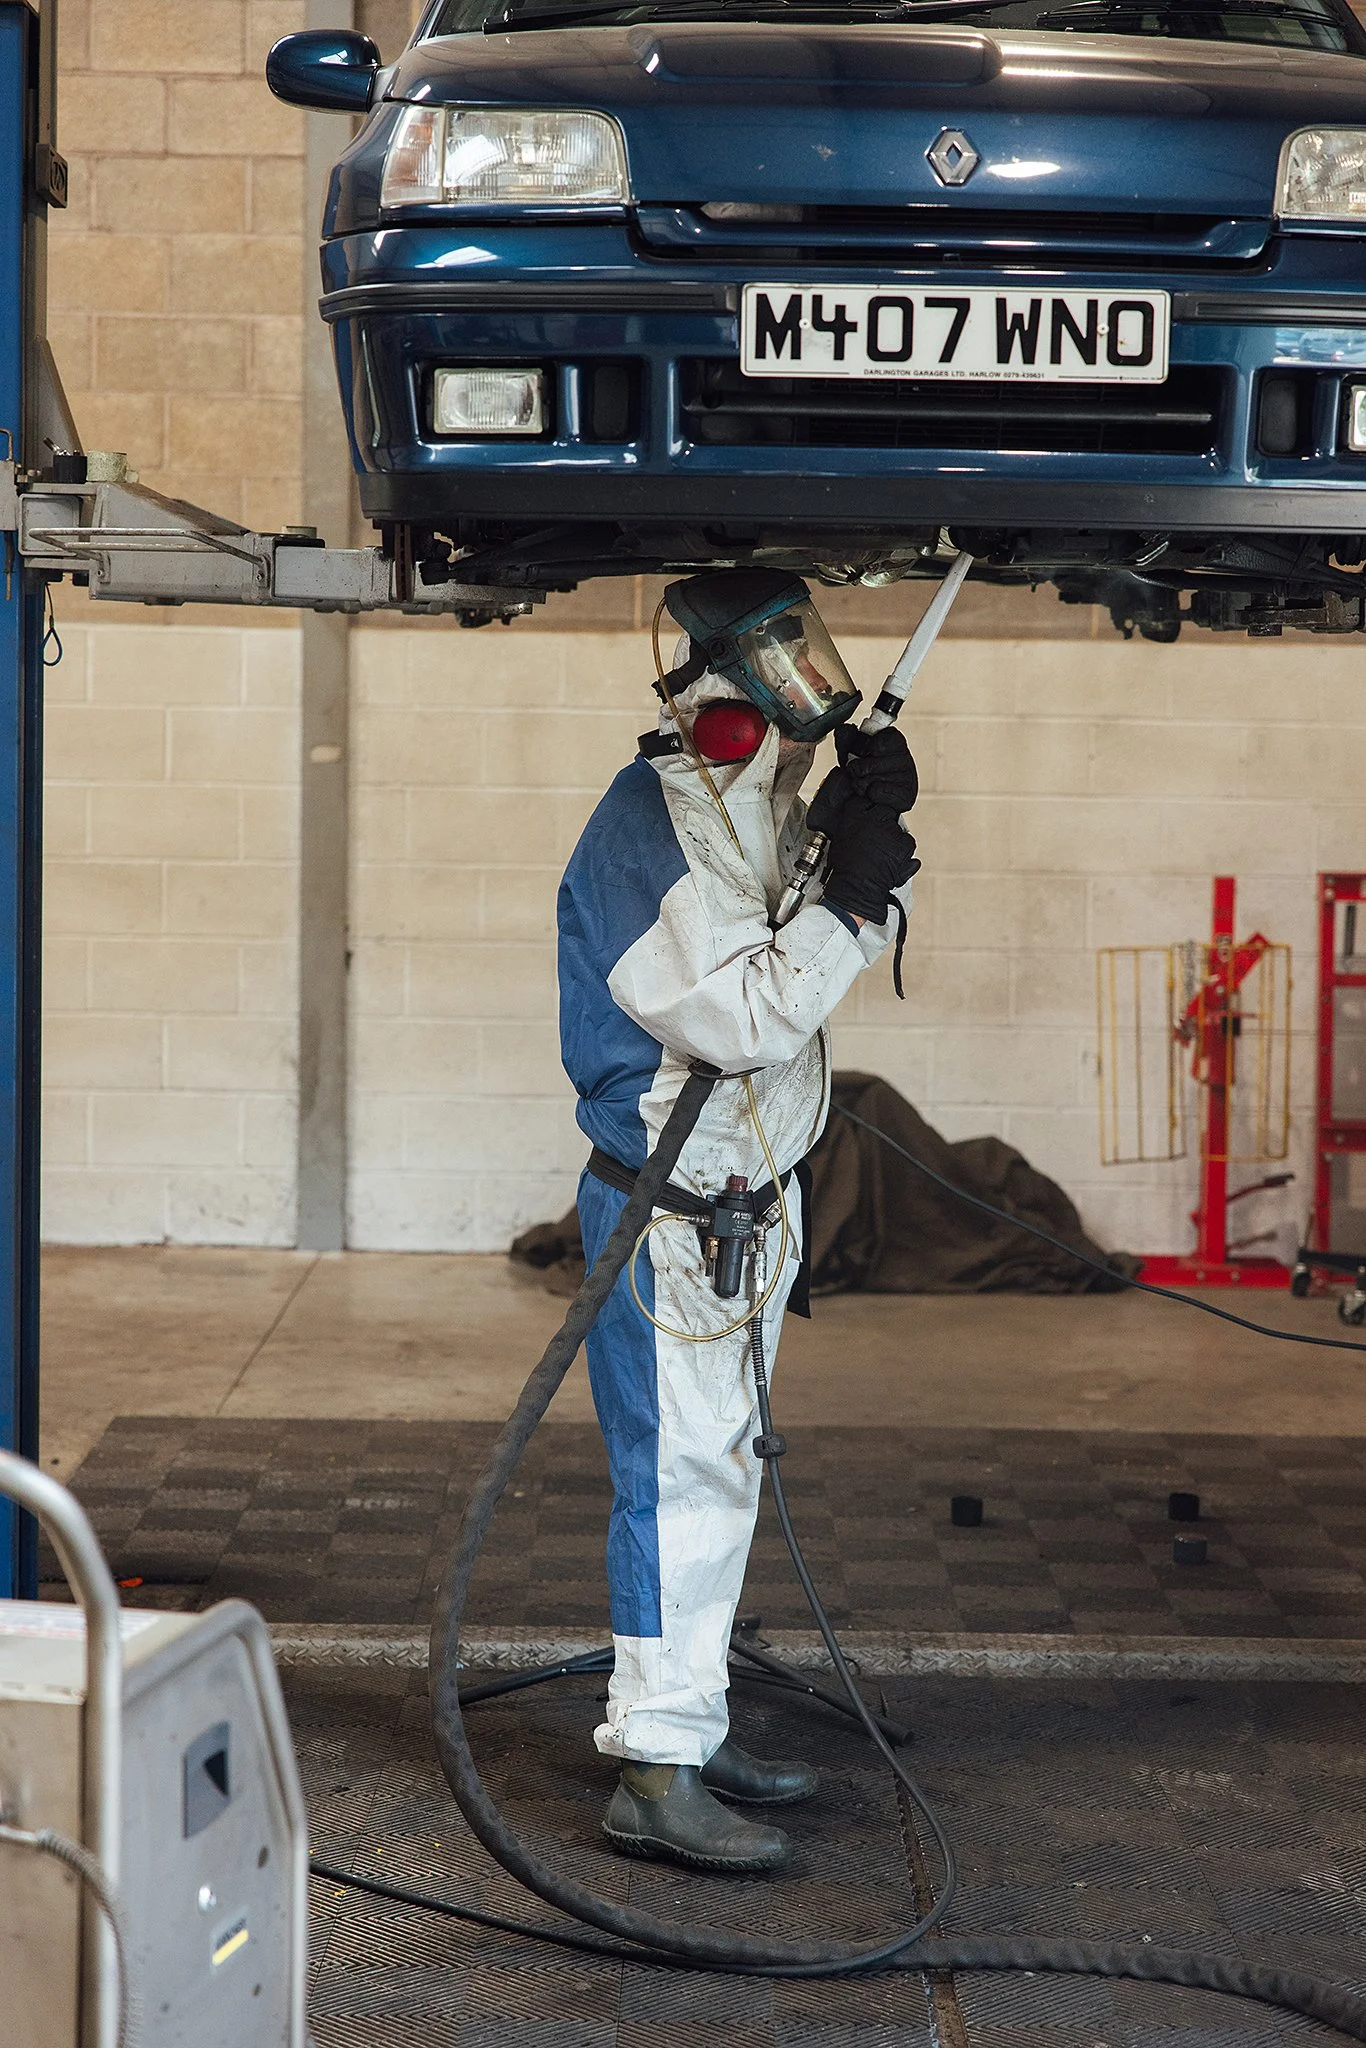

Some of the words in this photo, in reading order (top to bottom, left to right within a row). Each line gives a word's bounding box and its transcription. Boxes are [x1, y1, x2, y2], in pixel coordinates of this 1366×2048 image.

[754, 293, 971, 364] M407
[995, 297, 1155, 367] WNO
[863, 369, 911, 377] DARLINGTON
[913, 369, 949, 377] GARAGES
[969, 371, 1001, 379] HARLOW
